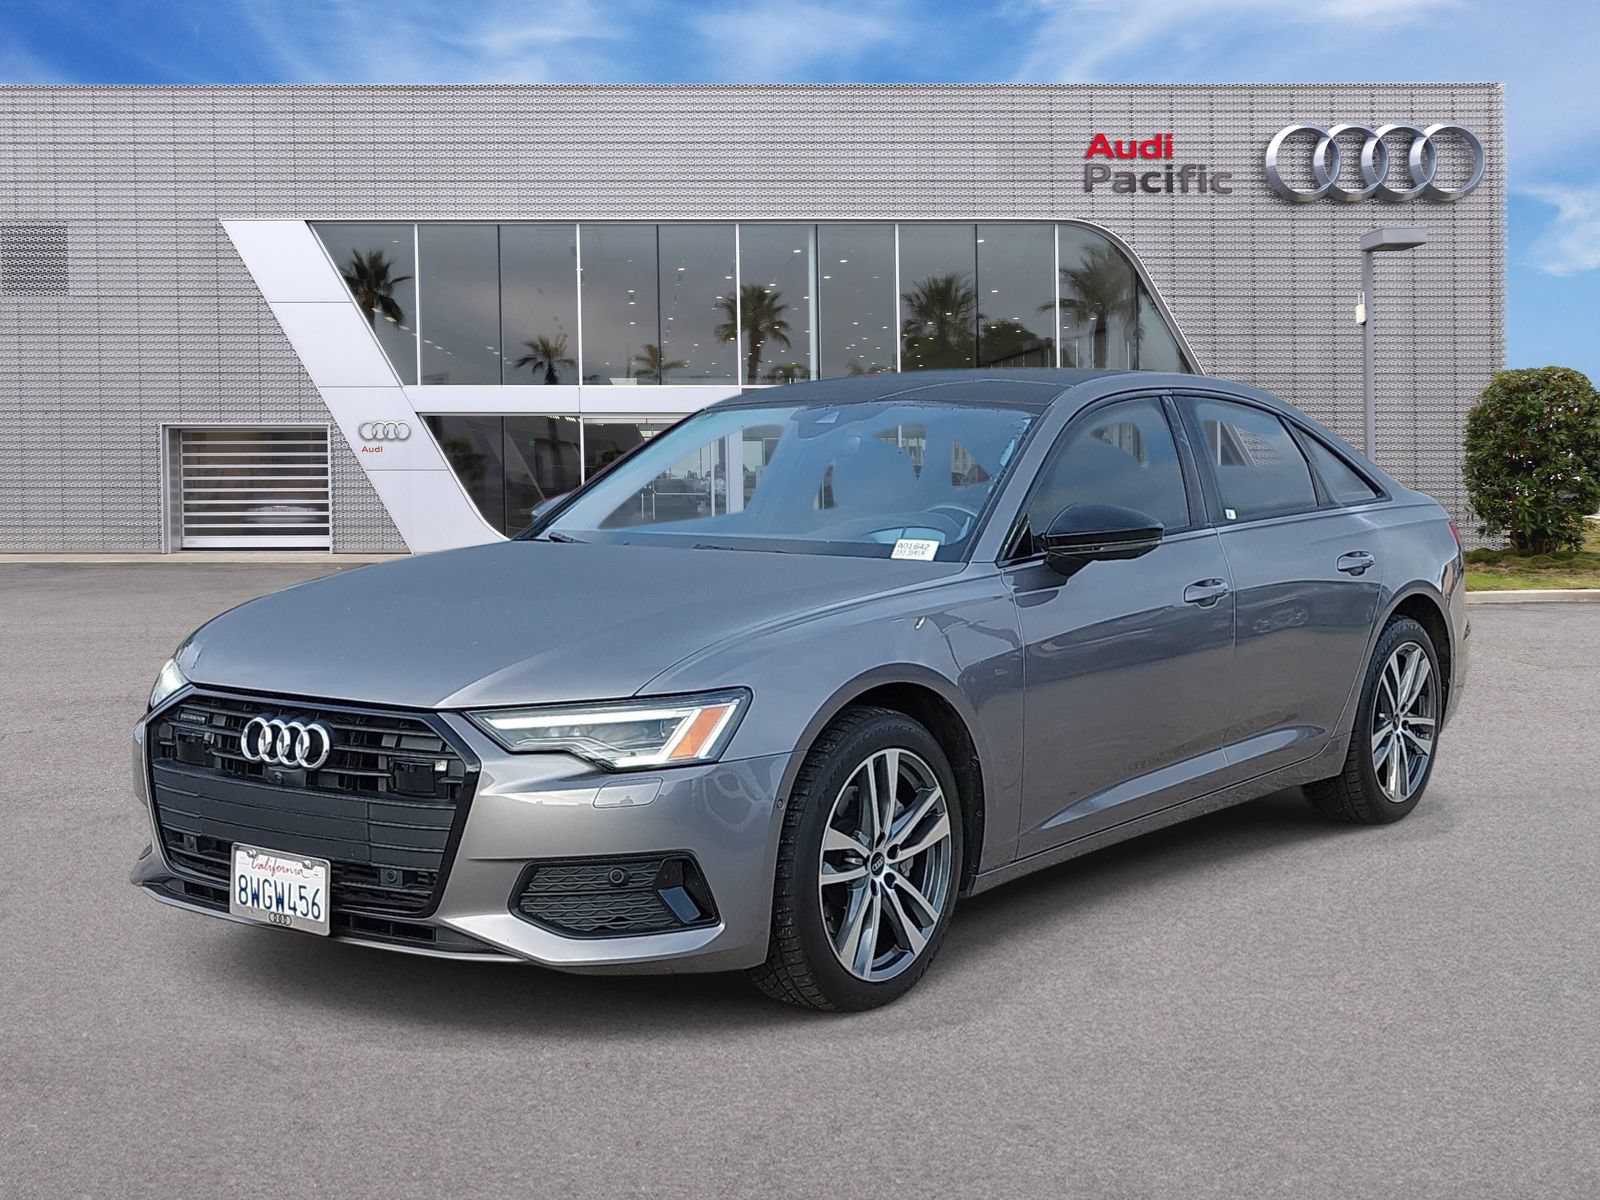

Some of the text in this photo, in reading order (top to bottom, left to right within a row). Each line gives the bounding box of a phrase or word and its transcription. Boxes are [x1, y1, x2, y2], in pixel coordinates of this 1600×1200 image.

[1085, 133, 1174, 160] Audi
[1083, 162, 1233, 194] Pacific
[361, 445, 384, 453] Audi
[251, 856, 310, 879] California
[238, 874, 321, 920] 8WGW456
